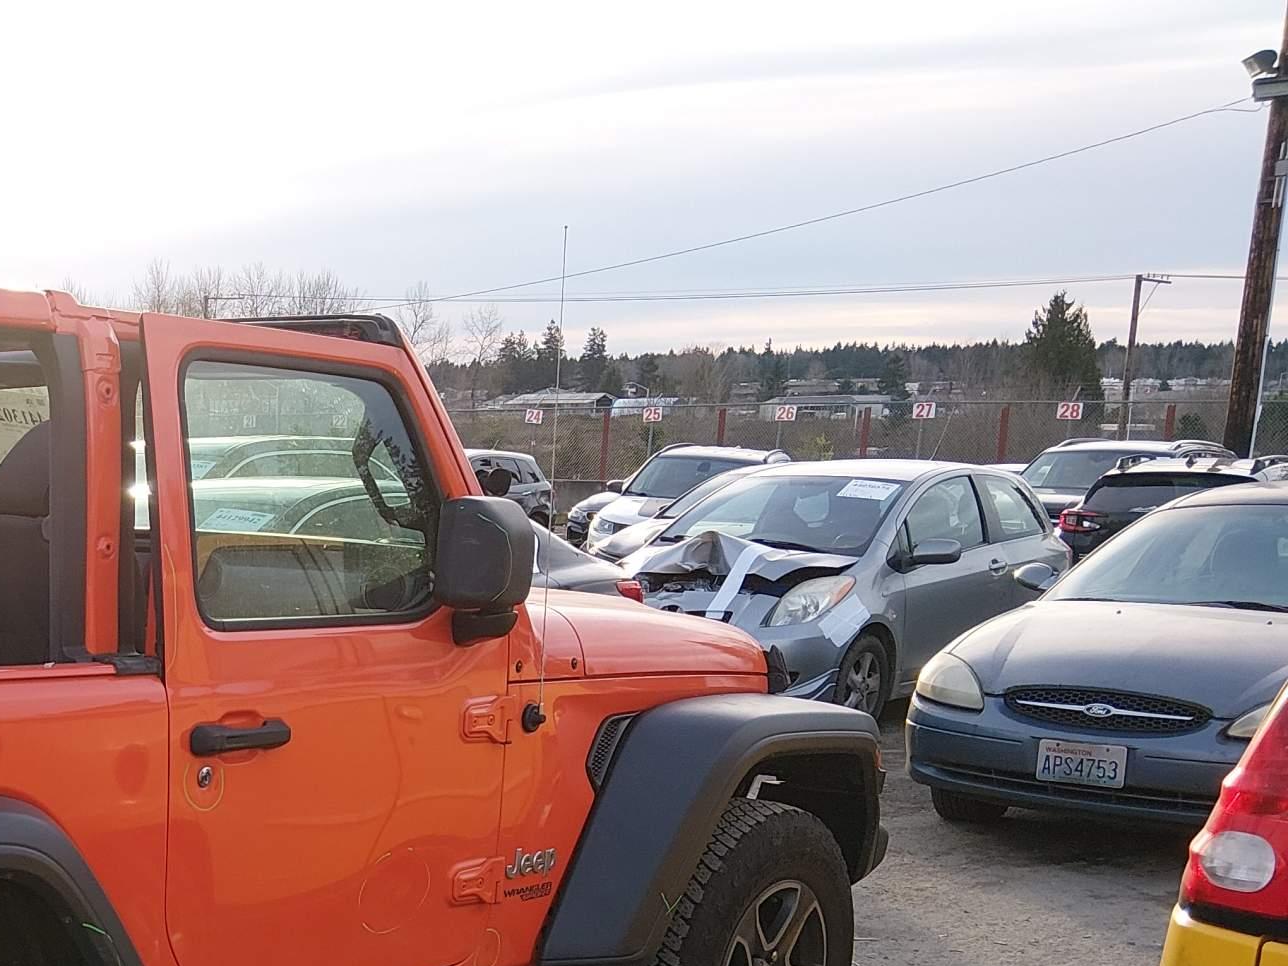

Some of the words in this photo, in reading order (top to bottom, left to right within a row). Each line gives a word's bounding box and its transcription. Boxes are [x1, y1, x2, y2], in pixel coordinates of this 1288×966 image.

[527, 410, 541, 423] 24
[645, 408, 661, 421] 25
[778, 406, 793, 420] 26
[916, 403, 933, 418] 27
[1059, 403, 1079, 419] 28
[1088, 705, 1108, 716] Ford
[1045, 746, 1093, 757] WASHINGTON
[1041, 755, 1119, 780] APS4753
[505, 848, 556, 880] Jeep
